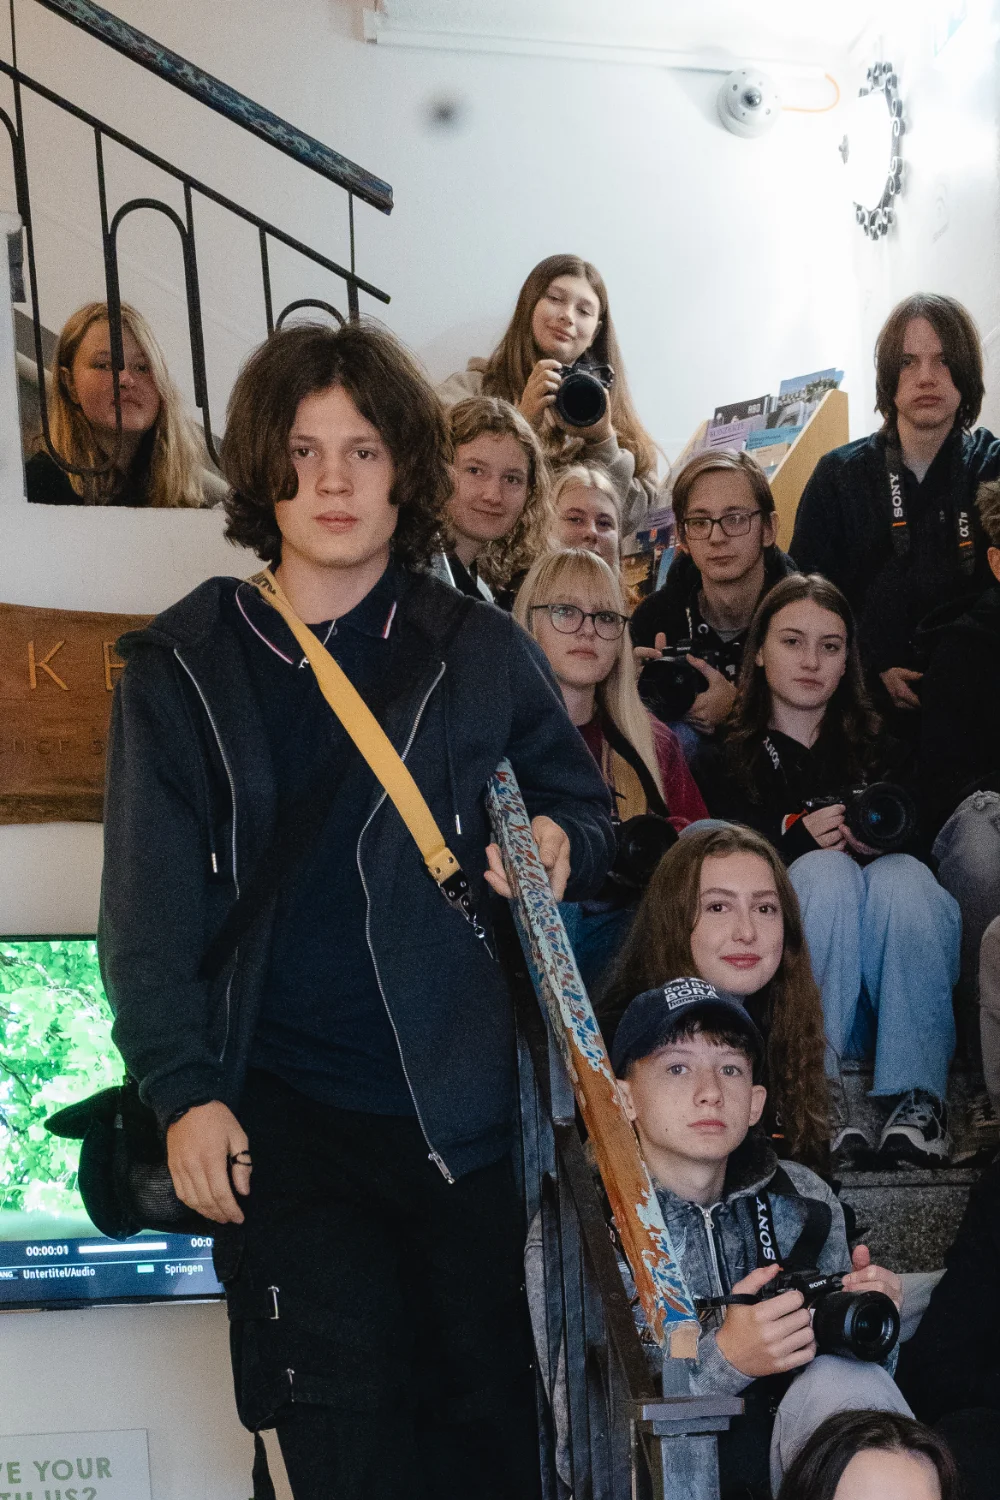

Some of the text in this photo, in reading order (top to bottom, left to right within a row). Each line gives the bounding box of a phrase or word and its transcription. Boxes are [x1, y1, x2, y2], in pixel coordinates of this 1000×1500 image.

[889, 472, 904, 518] SONY
[665, 987, 721, 1003] BORA
[755, 1196, 777, 1261] SONY
[25, 1245, 69, 1257] 00:00:01
[22, 1266, 96, 1280] Untertitel/Audio
[164, 1264, 204, 1276] Springen
[808, 1279, 828, 1290] SONY
[32, 1457, 113, 1482] YOUR
